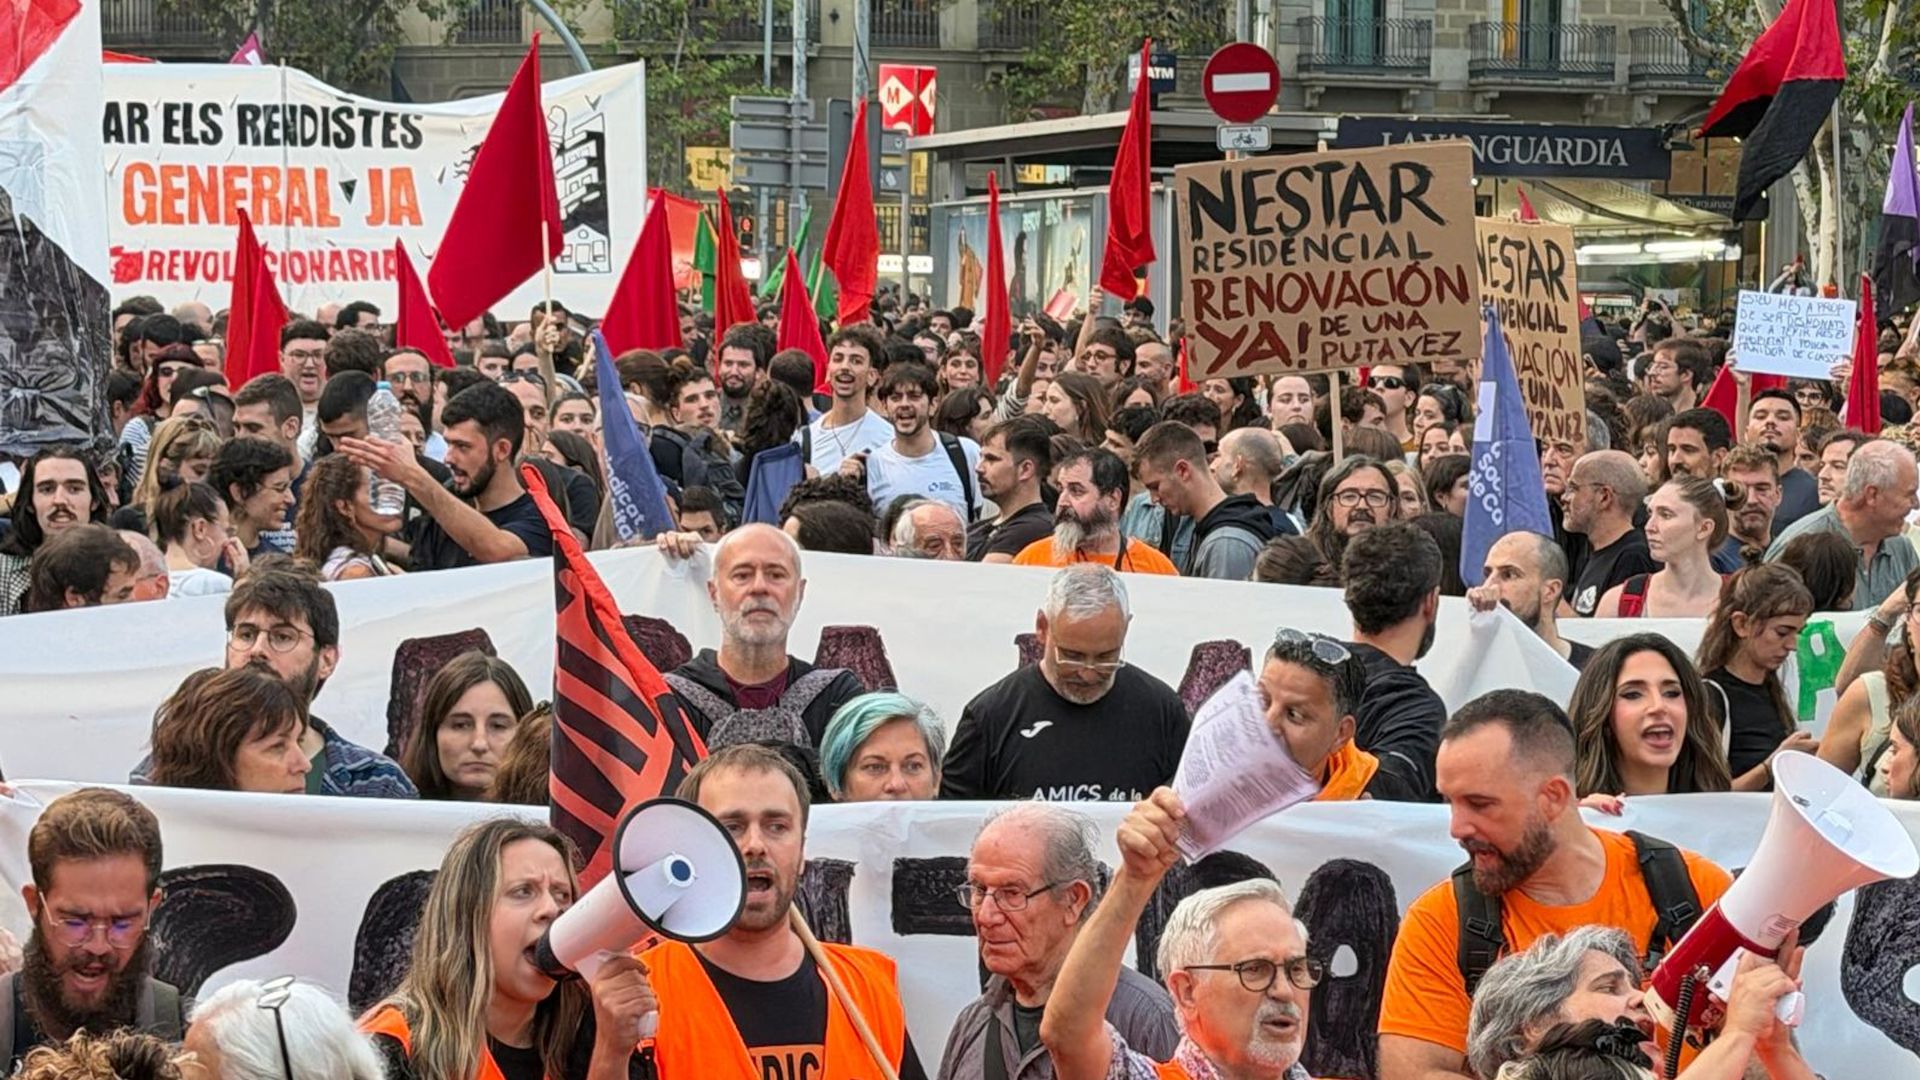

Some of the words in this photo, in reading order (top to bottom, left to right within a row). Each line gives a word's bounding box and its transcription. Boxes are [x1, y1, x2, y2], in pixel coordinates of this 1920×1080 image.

[103, 101, 149, 144] AR
[163, 102, 223, 145] ELS
[237, 103, 423, 149] RENDISTES
[122, 161, 340, 227] GENERAL
[365, 167, 423, 226] JA
[1187, 161, 1448, 242] NESTAR
[147, 249, 399, 283] REVOLCIONARIA
[1193, 230, 1433, 274] RESIDENCIAL
[1191, 261, 1470, 322] RENOVACIÓN
[1320, 315, 1350, 337] DE
[1362, 310, 1428, 334] UNA
[1321, 340, 1396, 366] PUTA
[1399, 331, 1462, 357] VEZ
[1528, 378, 1564, 411] UNA
[1527, 408, 1552, 438] UTA
[1032, 783, 1102, 801] AMICS
[1108, 787, 1127, 801] de
